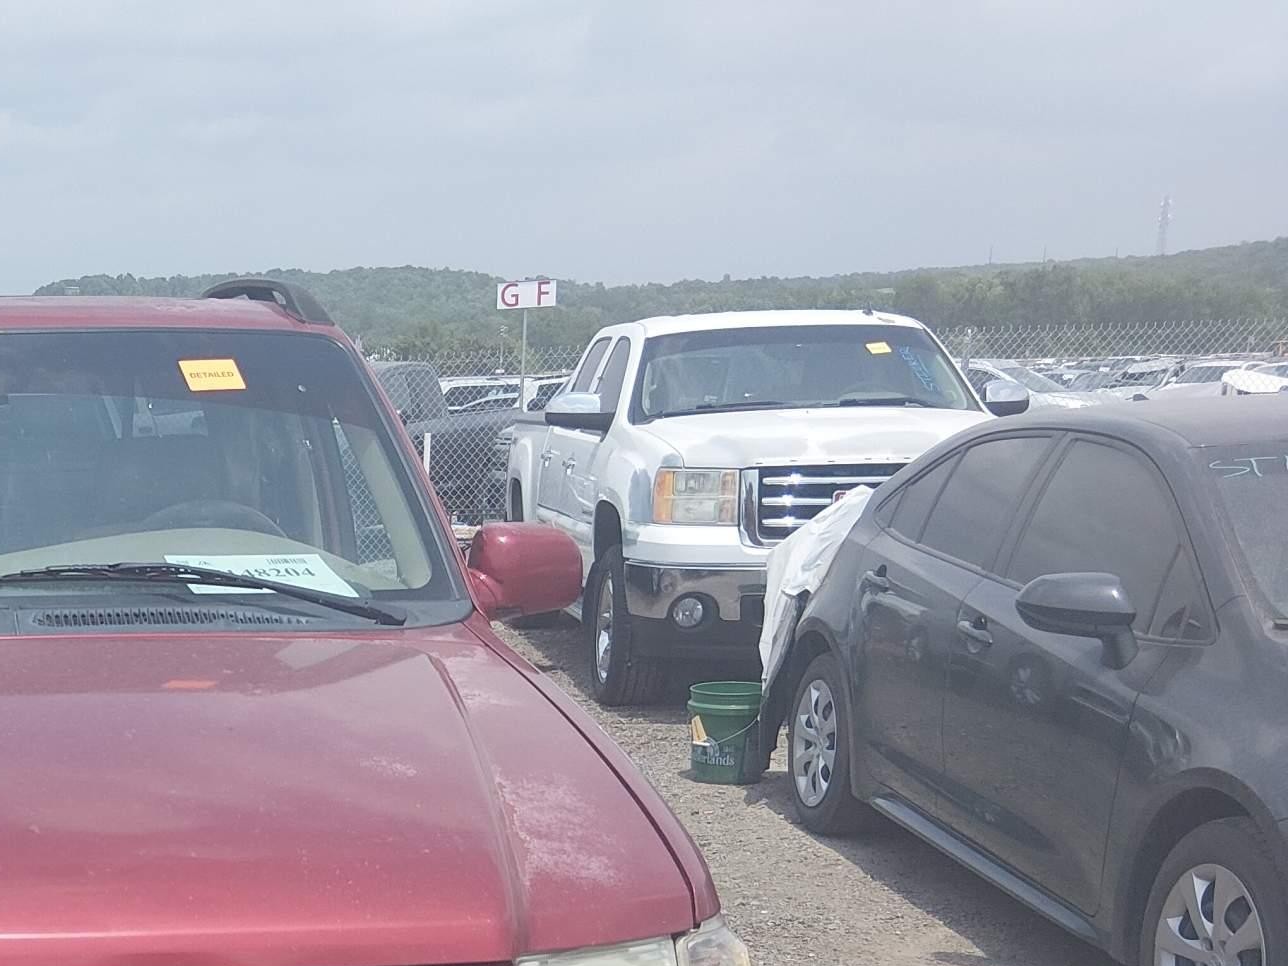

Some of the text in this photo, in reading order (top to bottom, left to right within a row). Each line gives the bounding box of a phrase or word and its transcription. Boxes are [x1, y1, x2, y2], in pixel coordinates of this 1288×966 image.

[500, 280, 551, 308] G F
[189, 371, 234, 379] DETAILED
[1209, 455, 1288, 477] ST
[226, 566, 316, 578] 48204
